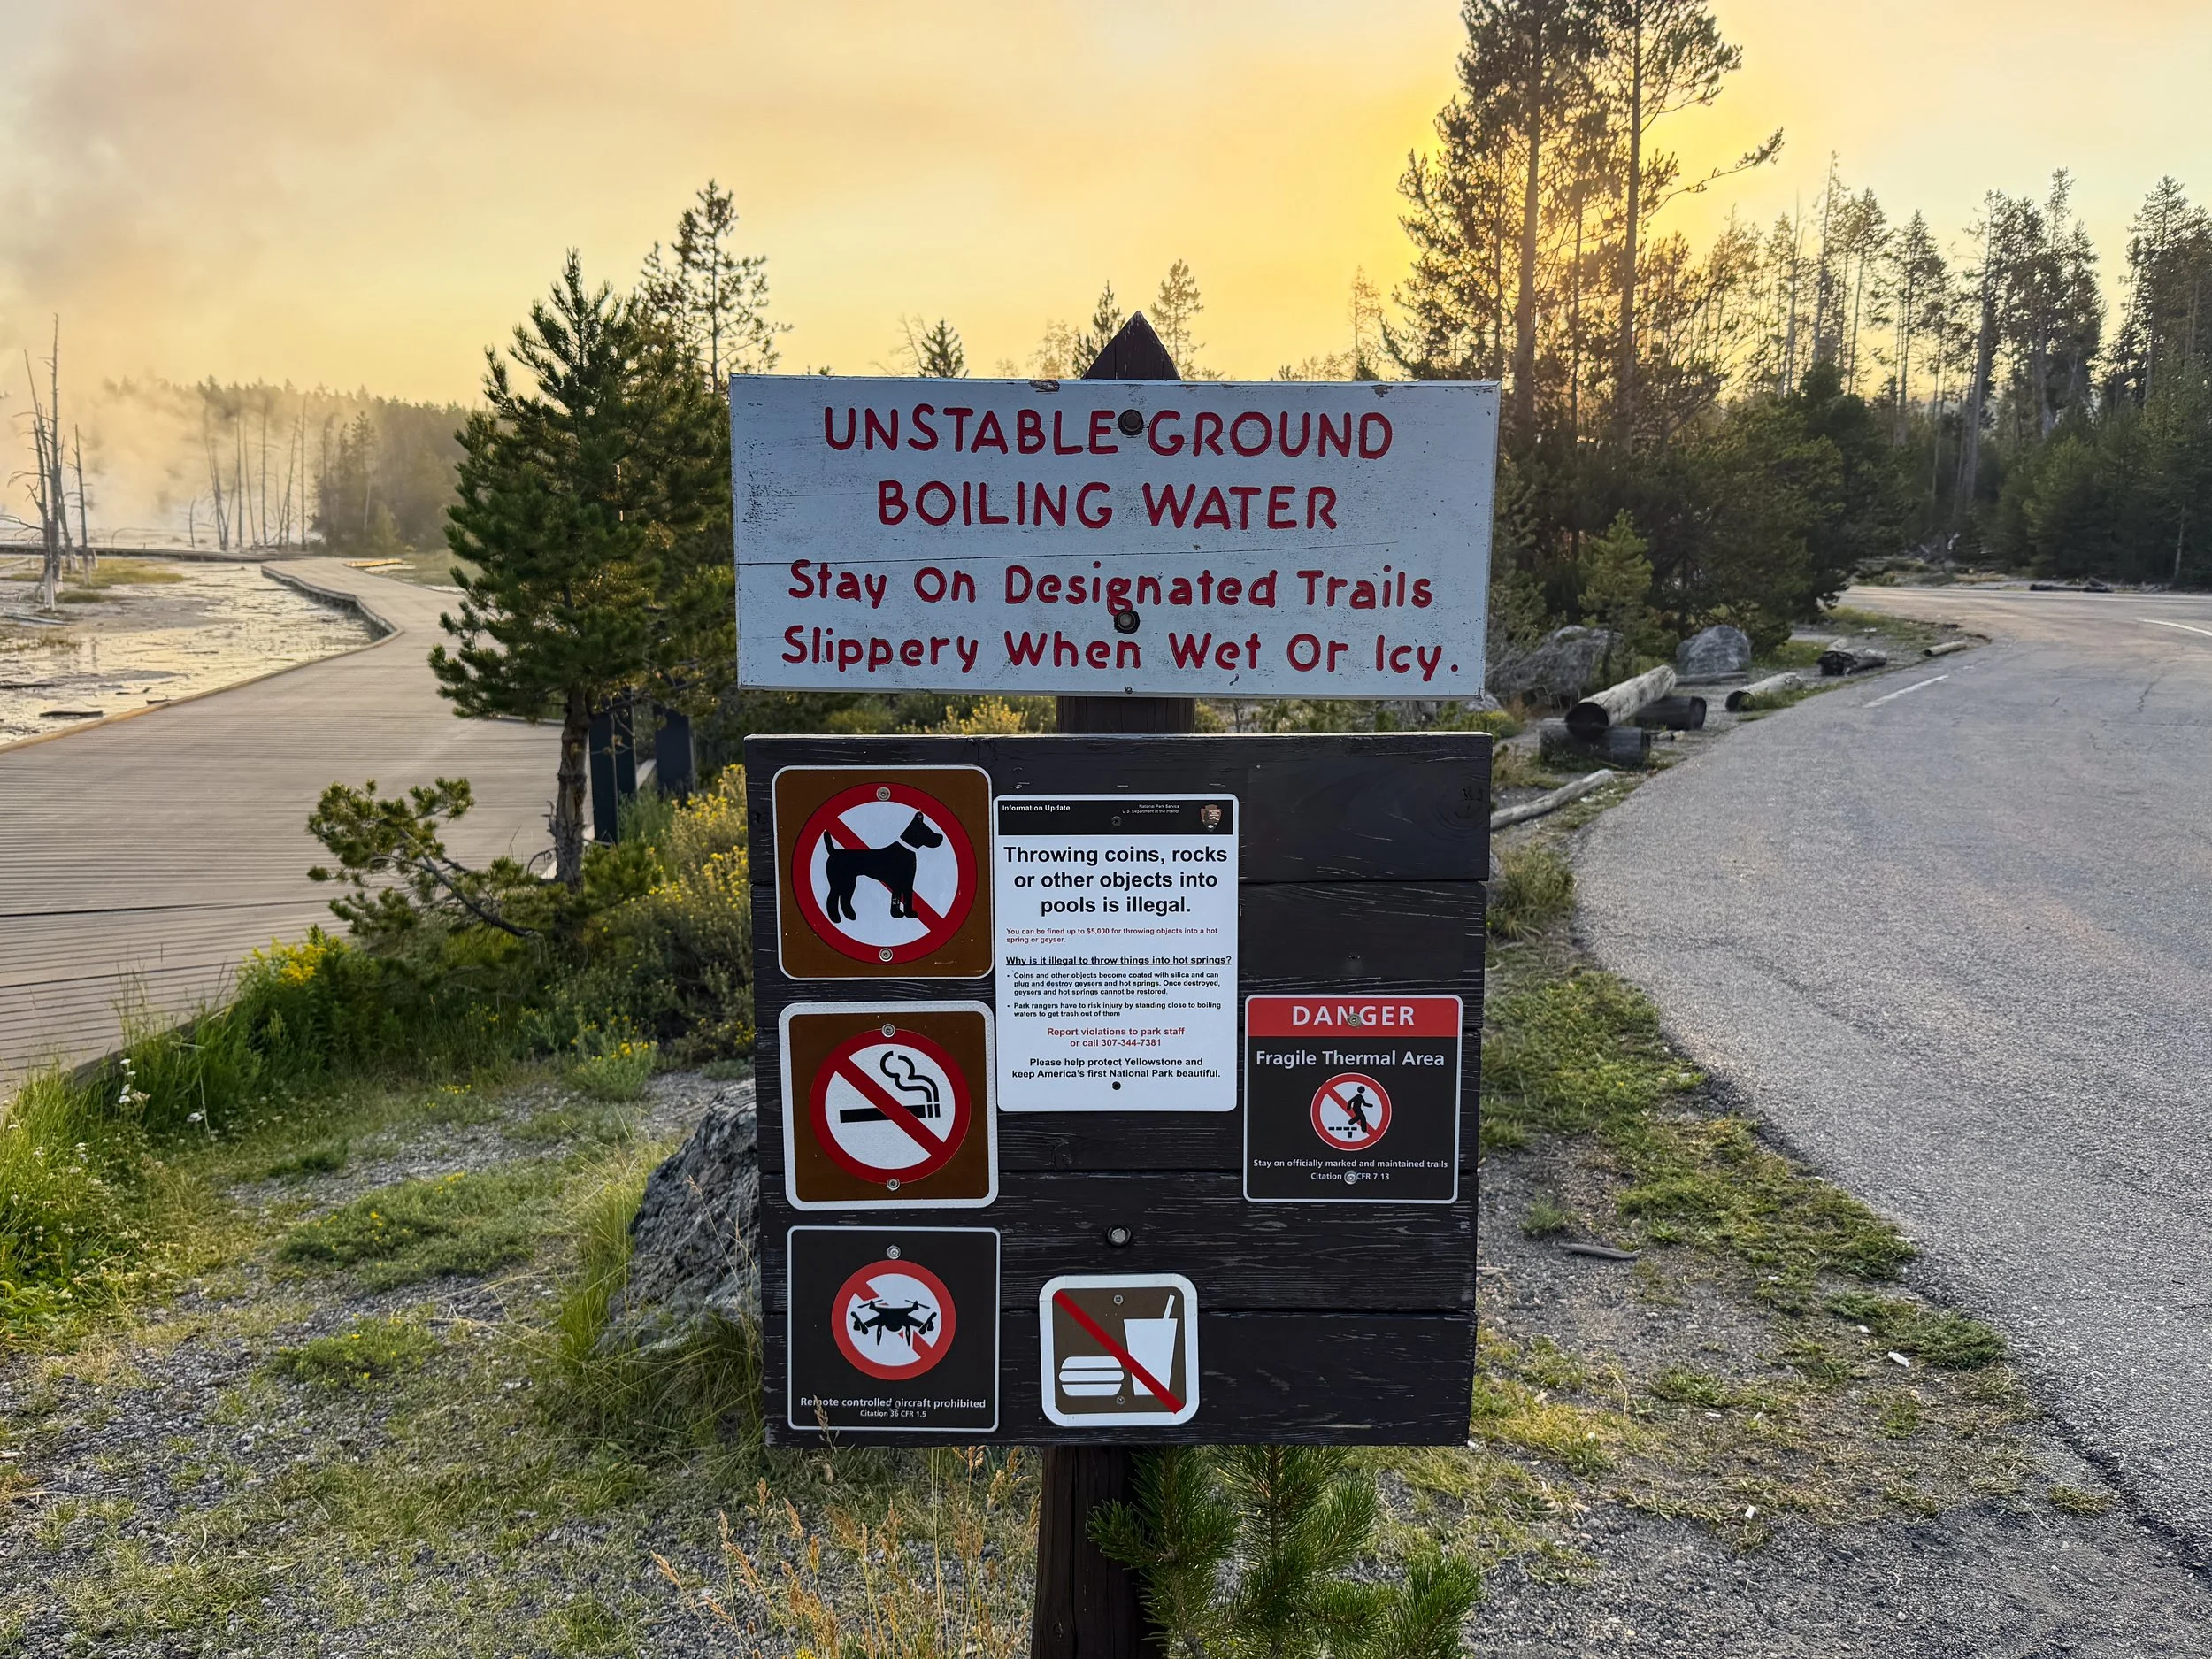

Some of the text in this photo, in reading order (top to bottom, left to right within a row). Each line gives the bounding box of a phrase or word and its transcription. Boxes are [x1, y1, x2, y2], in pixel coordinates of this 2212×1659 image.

[824, 404, 1394, 461] UNSTABLE GROUND
[878, 480, 1338, 531] BOILING WATER
[789, 559, 1433, 615] Stay On Designated Trails
[782, 625, 1459, 682] Slippery When Wet Or Icy.
[1045, 805, 1070, 813] Update
[1003, 845, 1228, 867] Throwing coins, rocks
[1014, 871, 1218, 892] or other objects into
[1041, 896, 1191, 917] pools is illegal.
[1123, 928, 1155, 936] throwing
[1156, 928, 1183, 936] objects
[1006, 936, 1029, 944] spring
[1005, 956, 1027, 965] Why
[1048, 956, 1076, 965] illegal
[1120, 956, 1150, 965] things
[1190, 955, 1232, 965] springs?
[1071, 972, 1097, 980] objects
[1133, 980, 1161, 988] springs.
[1183, 980, 1220, 988] destroyed,
[1071, 988, 1099, 997] springs
[1102, 1002, 1123, 1010] injury
[1197, 1002, 1221, 1010] boiling
[1293, 1005, 1414, 1027] DANGER
[1047, 1028, 1079, 1038] Report
[1080, 1027, 1126, 1036] violations
[1141, 1027, 1161, 1037] park
[1164, 1027, 1185, 1035] staff
[1082, 1039, 1099, 1047] call
[1101, 1038, 1161, 1047] 307-344-7381
[1029, 1058, 1203, 1068] Please help protect Yellowstone and
[1256, 1050, 1444, 1069] Fragile Thermal Area
[1012, 1069, 1221, 1080] keep America's first National Park beautiful.
[1253, 1159, 1272, 1169] Stay
[1287, 1158, 1323, 1169] officially
[1325, 1159, 1357, 1167] marked
[1377, 1159, 1425, 1168] maintained
[1310, 1172, 1342, 1180] Citation
[1355, 1172, 1371, 1181] CFR
[841, 1397, 892, 1407] controlled
[933, 1398, 986, 1409] prohibited
